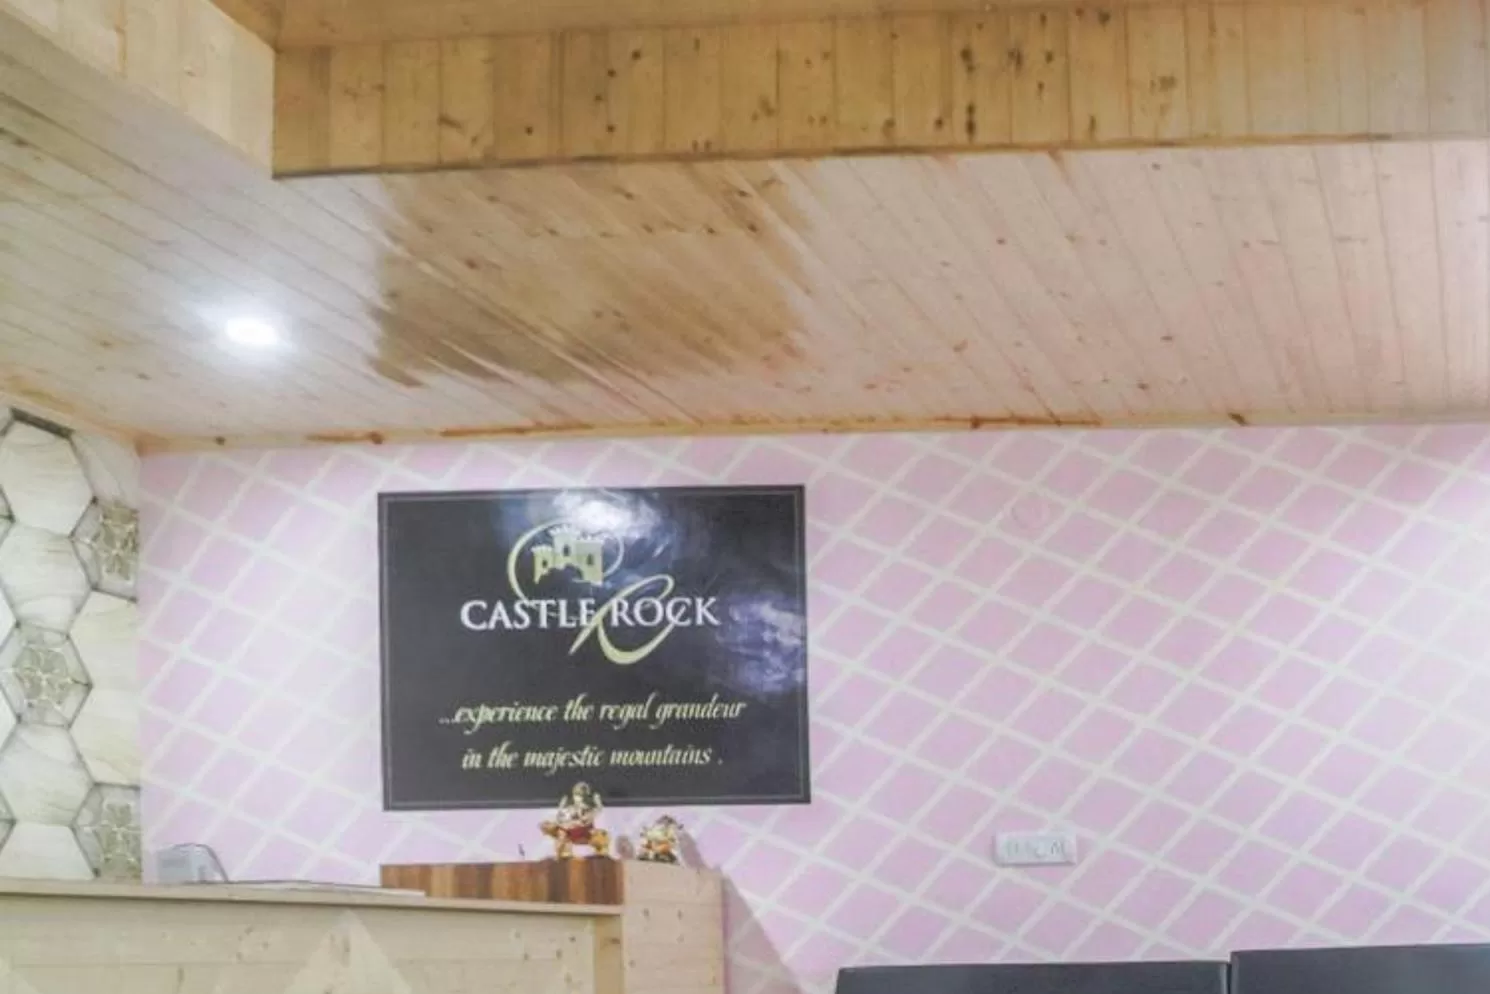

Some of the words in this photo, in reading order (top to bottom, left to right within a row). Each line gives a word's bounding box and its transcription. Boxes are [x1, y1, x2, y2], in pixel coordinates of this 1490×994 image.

[460, 599, 597, 630] CASTLE
[610, 596, 721, 627] ROCK
[563, 692, 595, 721] the
[600, 690, 658, 730] regal
[649, 692, 747, 730] grandeur
[462, 748, 482, 769] in
[487, 740, 519, 769] the
[523, 745, 604, 776] majestic
